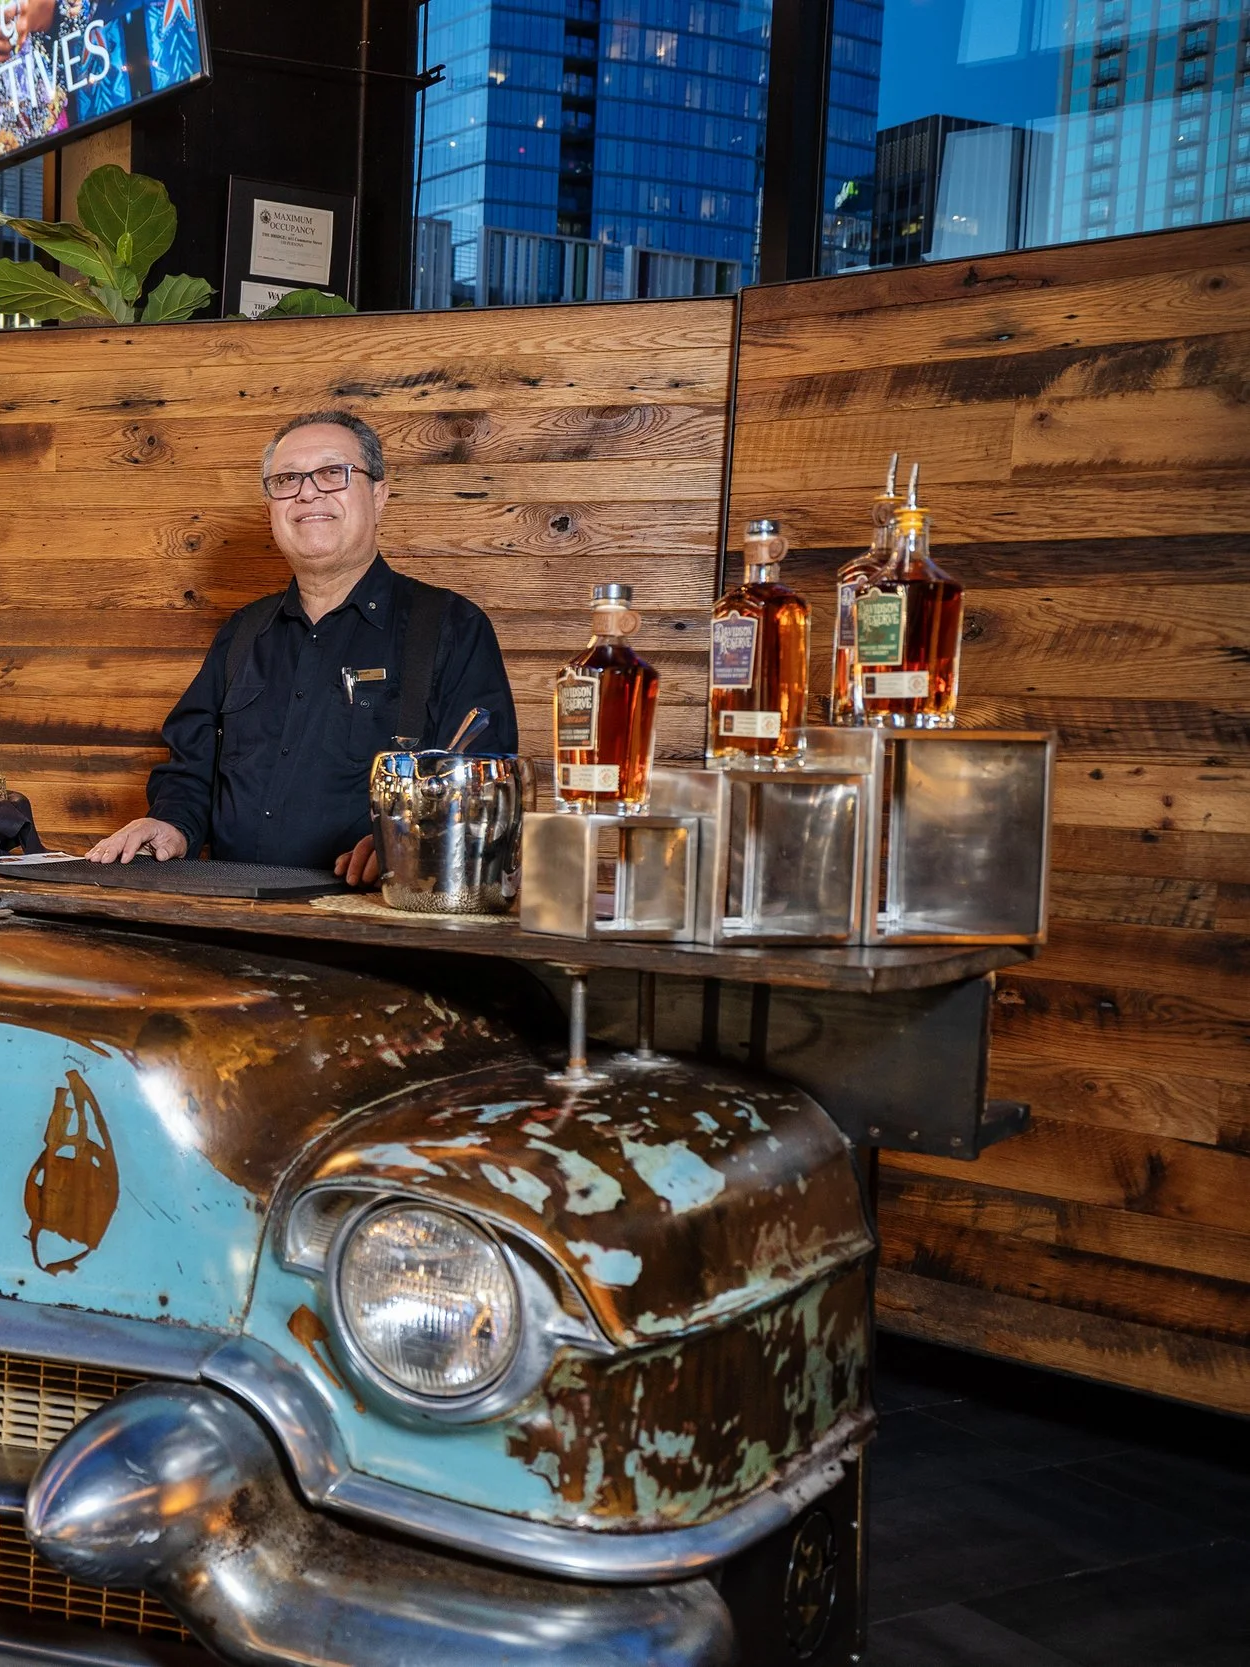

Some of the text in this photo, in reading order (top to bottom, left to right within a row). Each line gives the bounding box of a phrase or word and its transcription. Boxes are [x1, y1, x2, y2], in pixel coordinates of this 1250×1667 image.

[274, 212, 312, 225] MAXIMUM
[270, 222, 316, 235] OCCUPANCY
[862, 613, 899, 631] RESERVE
[714, 623, 753, 641] DAVIDSON
[720, 636, 752, 654] RESERVE
[561, 697, 592, 714] RESERVE
